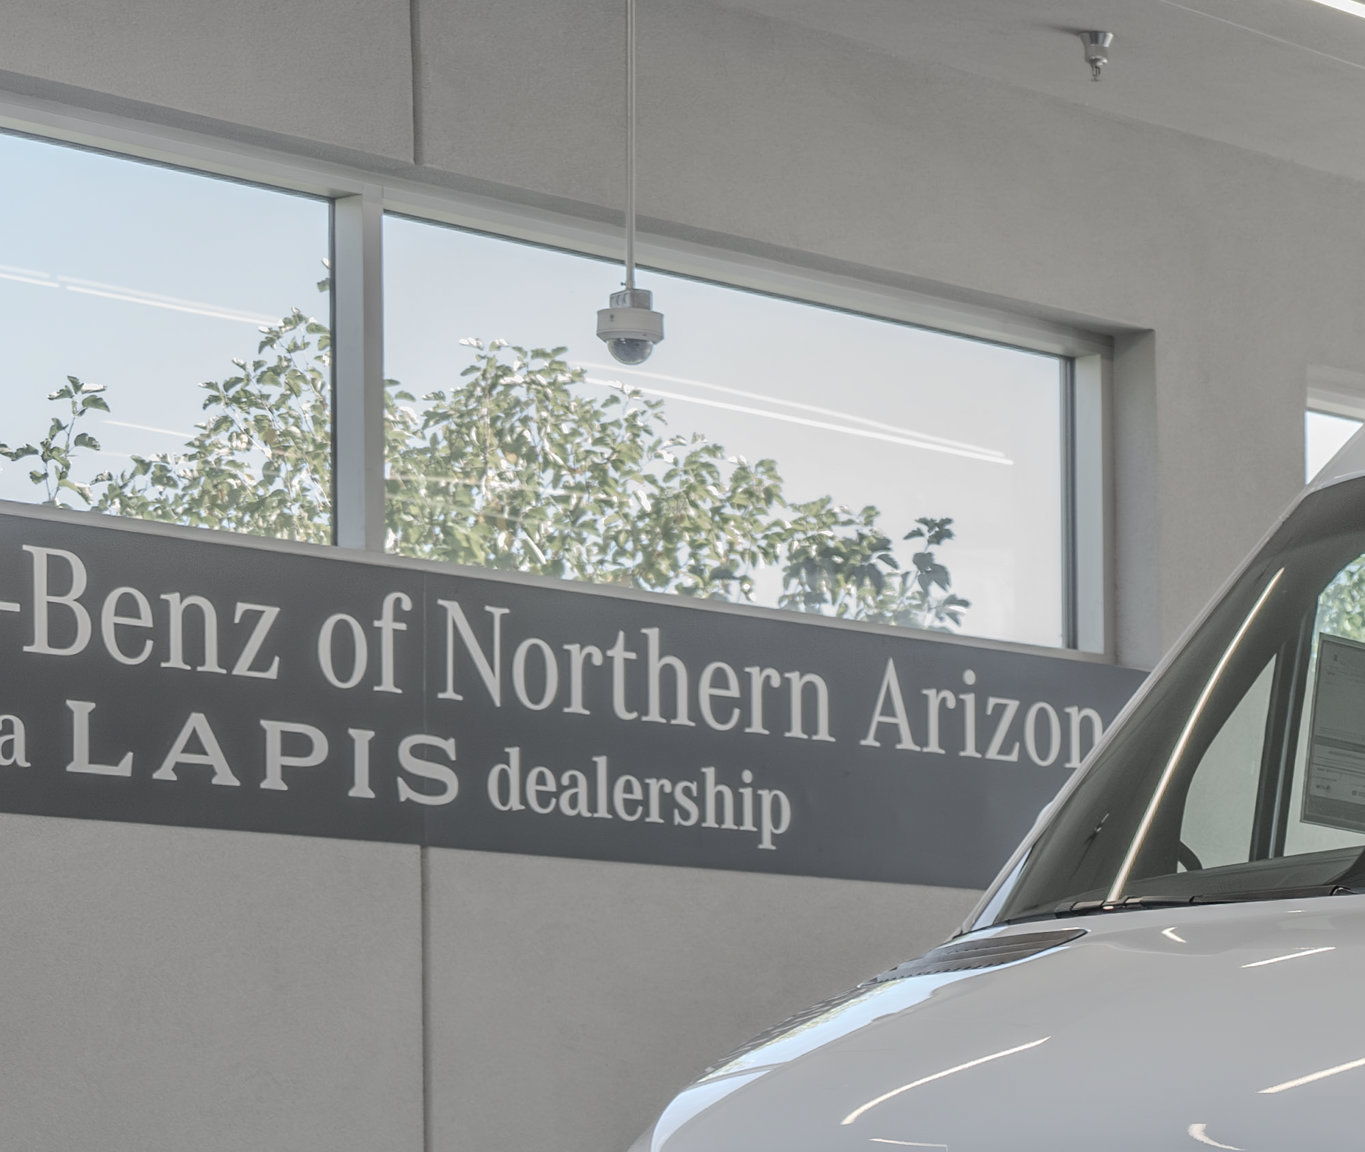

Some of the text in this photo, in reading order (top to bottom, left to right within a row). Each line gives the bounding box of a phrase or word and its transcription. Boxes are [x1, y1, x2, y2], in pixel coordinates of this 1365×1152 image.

[318, 592, 413, 694] of
[437, 599, 836, 743] Northern
[0, 699, 792, 850] a LAPIS dealership
